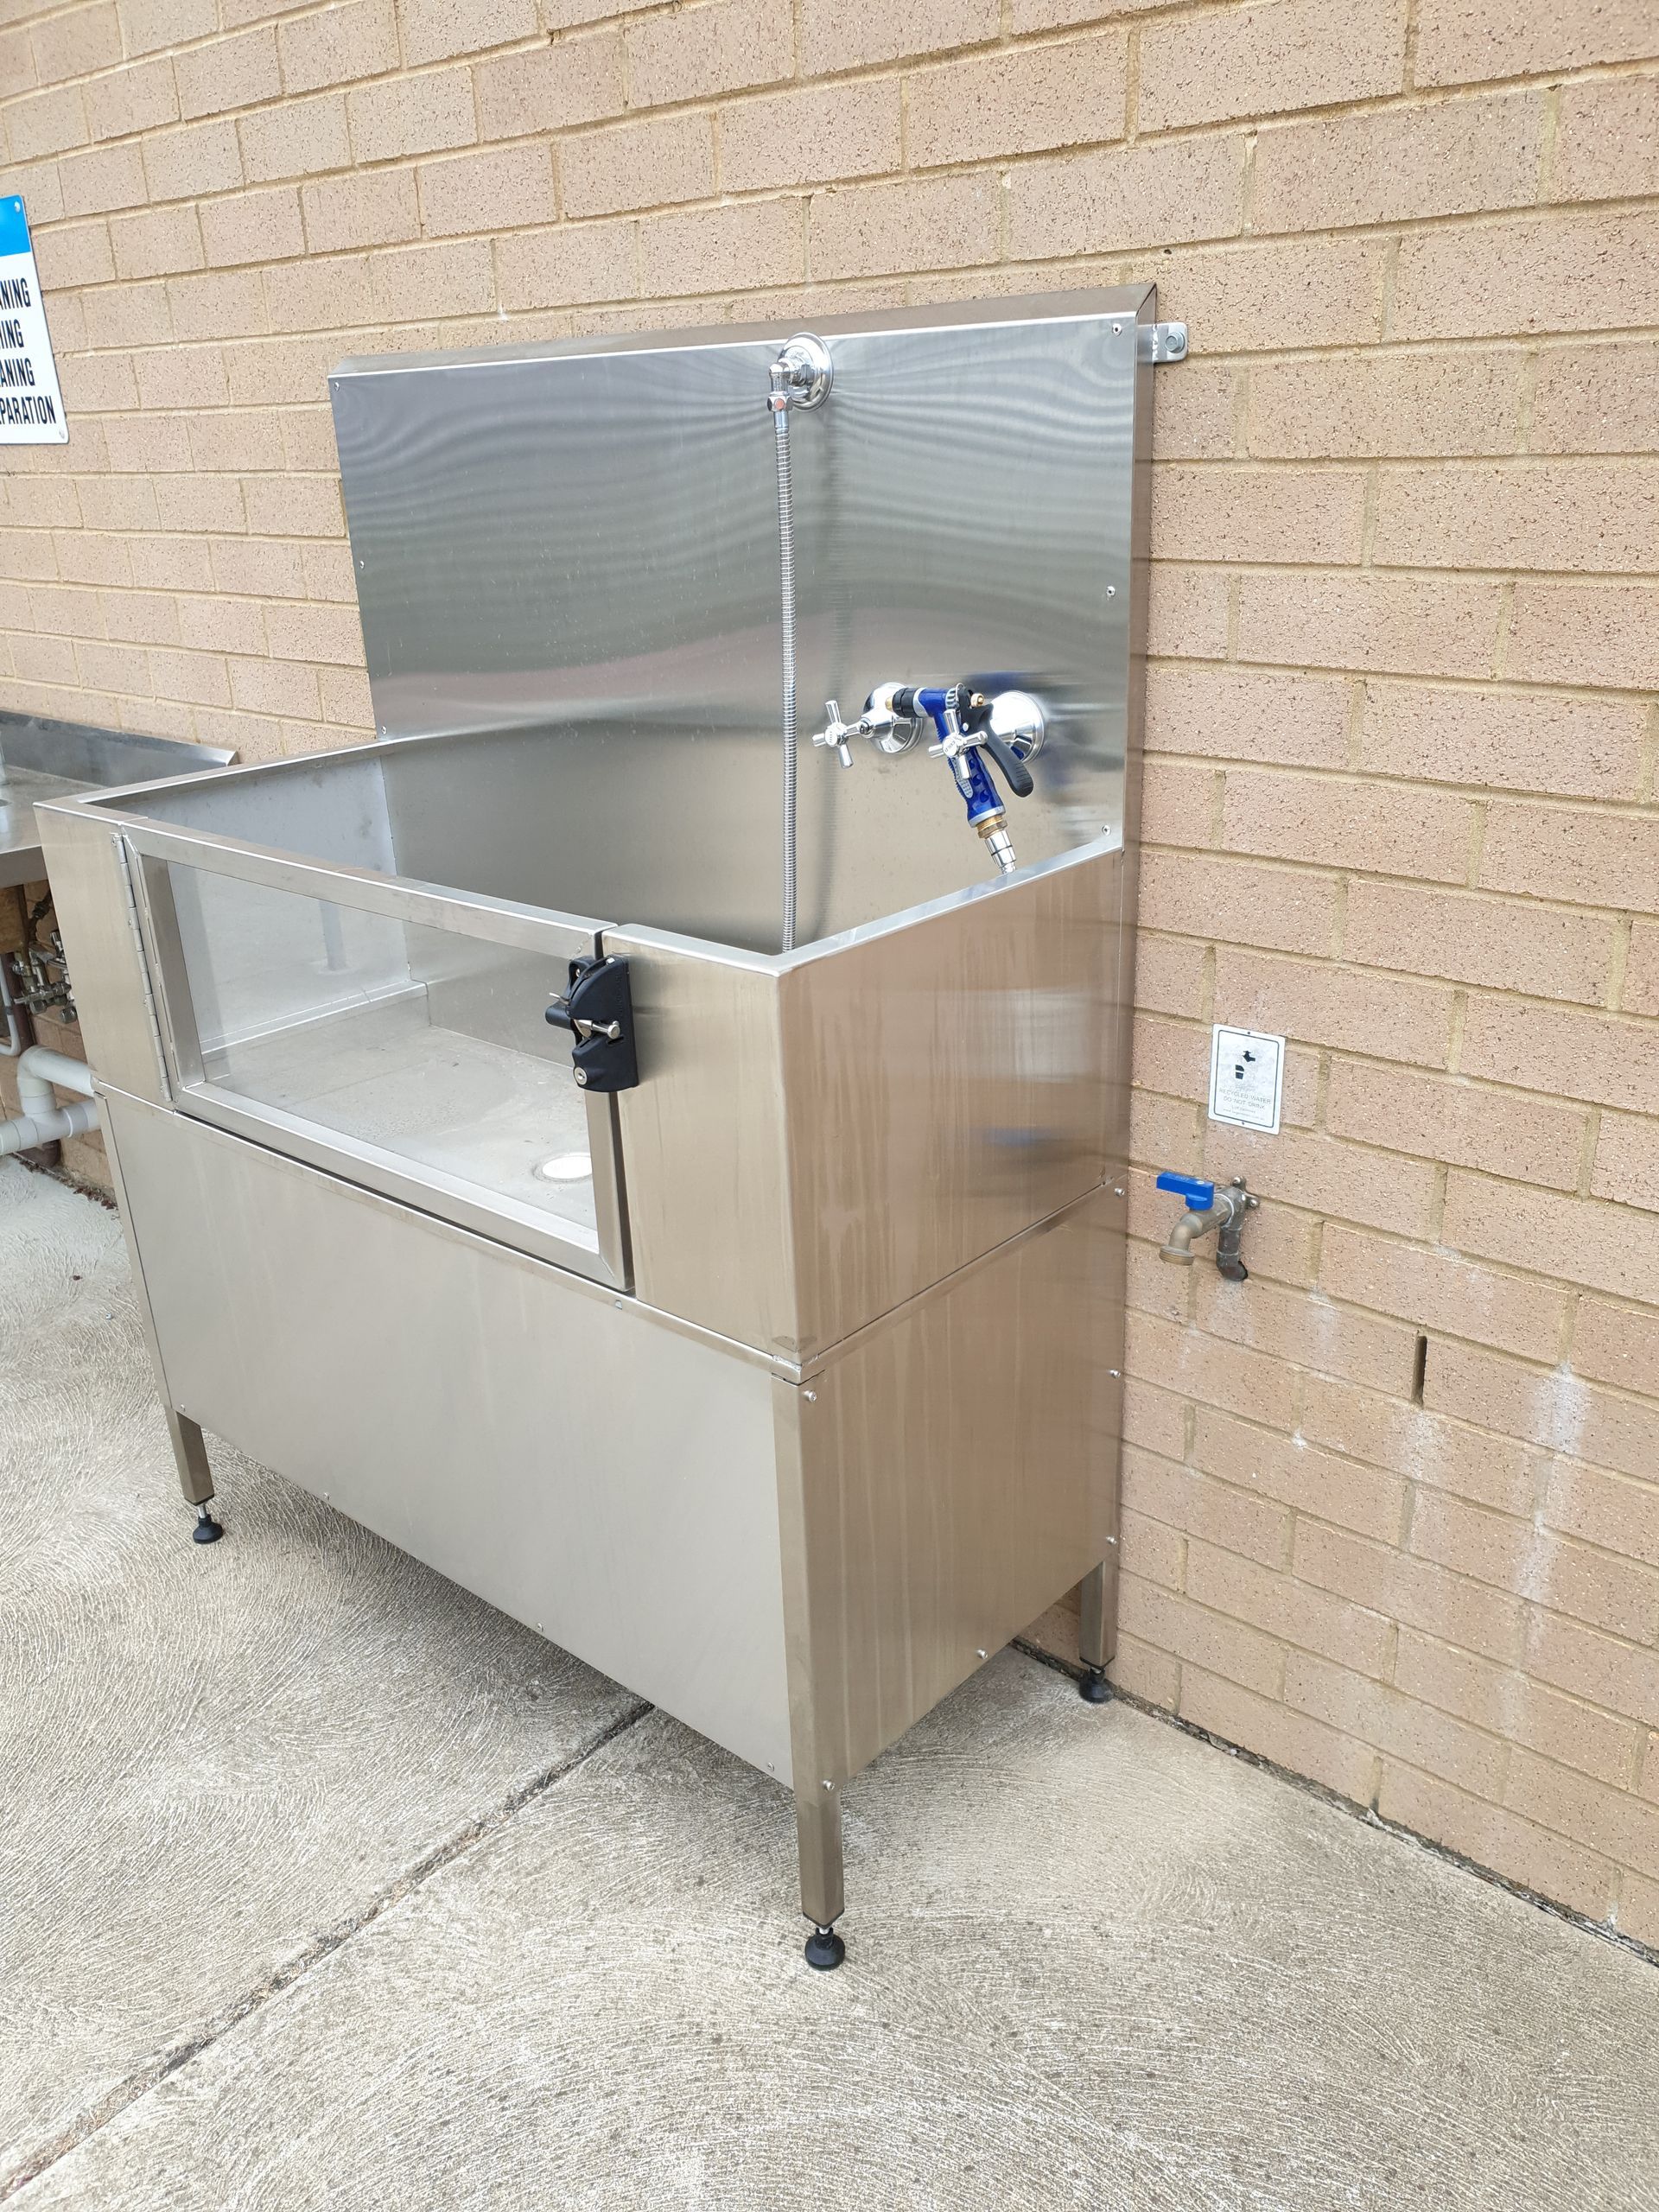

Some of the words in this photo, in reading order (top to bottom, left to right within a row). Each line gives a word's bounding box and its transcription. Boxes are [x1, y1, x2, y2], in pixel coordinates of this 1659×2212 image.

[0, 396, 56, 424] PARATION
[1219, 1088, 1249, 1099] RECYCLED
[1251, 1095, 1271, 1104] WATER
